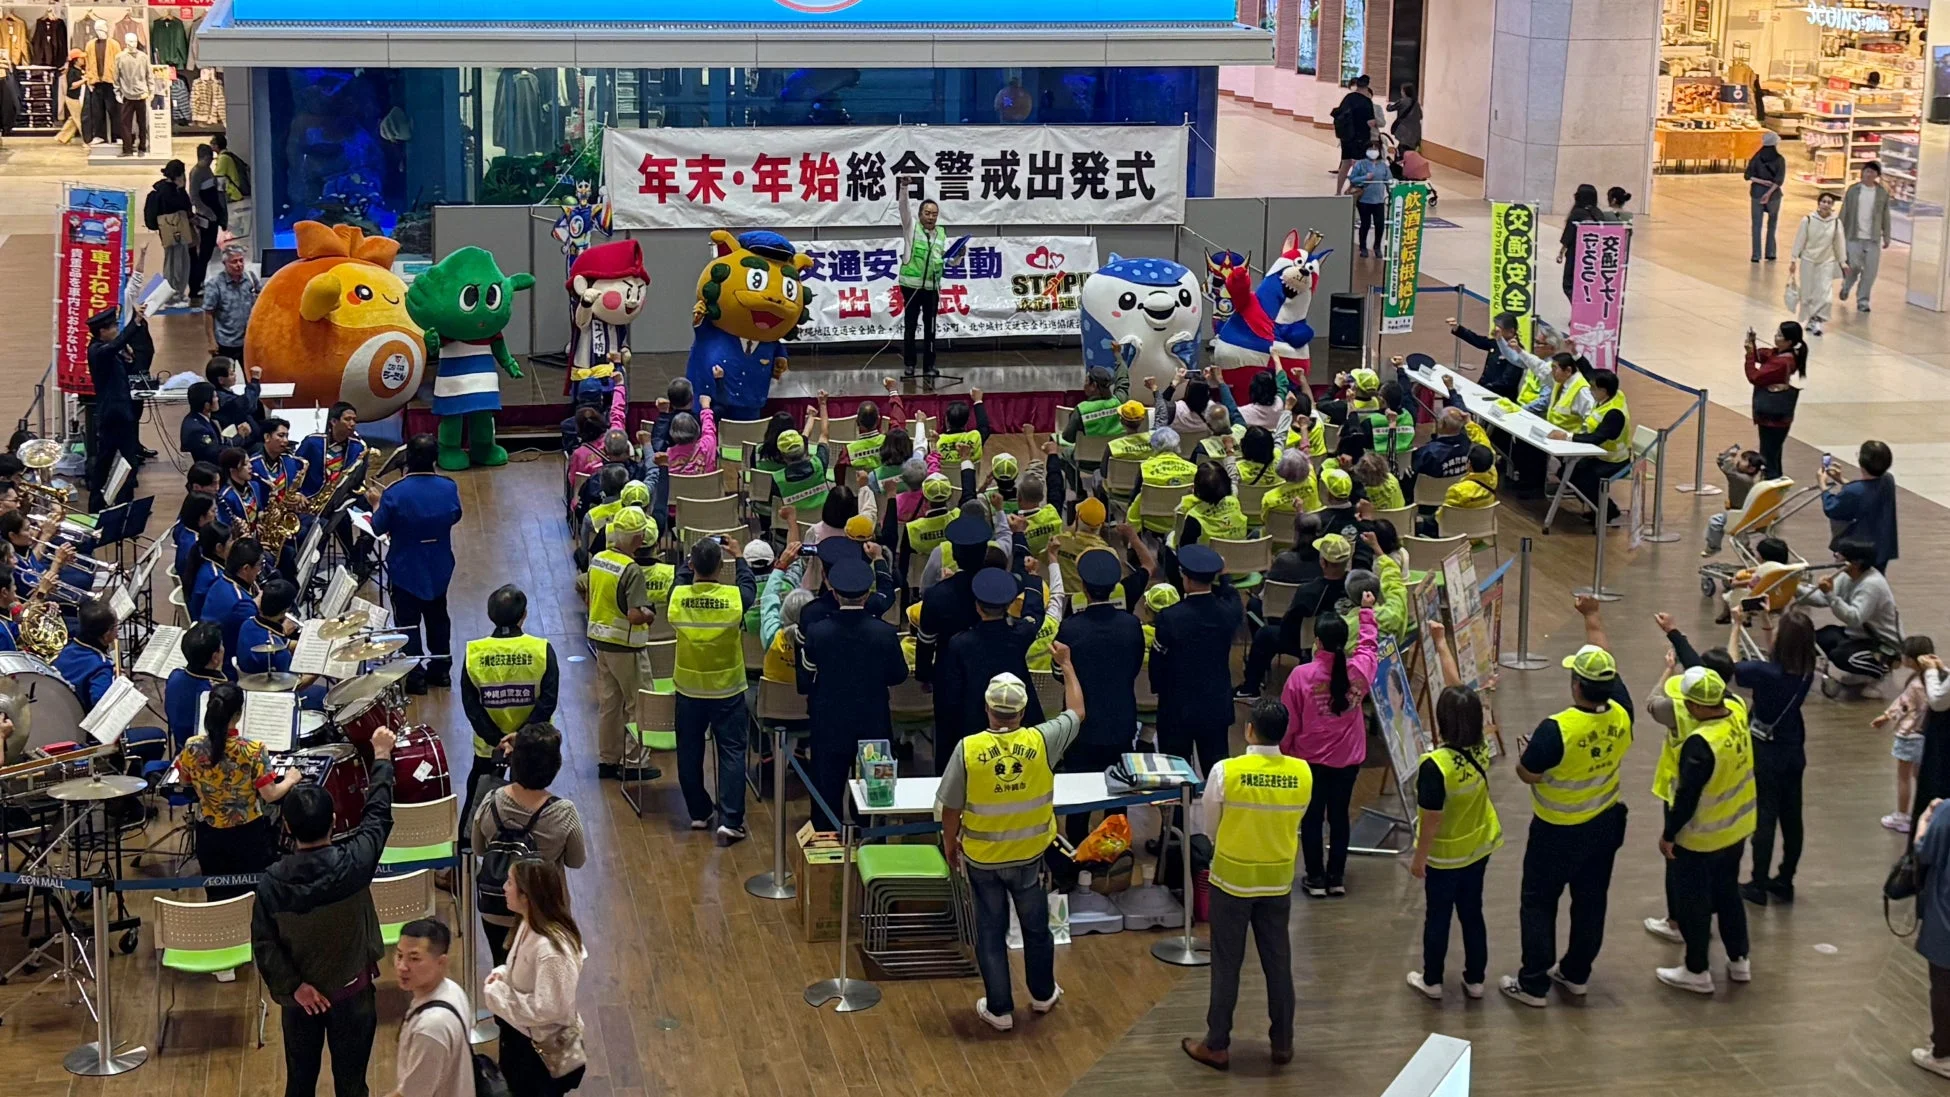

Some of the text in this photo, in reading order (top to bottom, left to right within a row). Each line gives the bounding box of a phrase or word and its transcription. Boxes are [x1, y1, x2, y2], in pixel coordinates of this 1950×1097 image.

[638, 151, 1156, 205] 年末・年始総合警戒出発式
[798, 246, 1003, 283] 交通安運動
[1504, 208, 1530, 312] 交通安全
[1240, 773, 1299, 789] 沖縄地区交通安全協会
